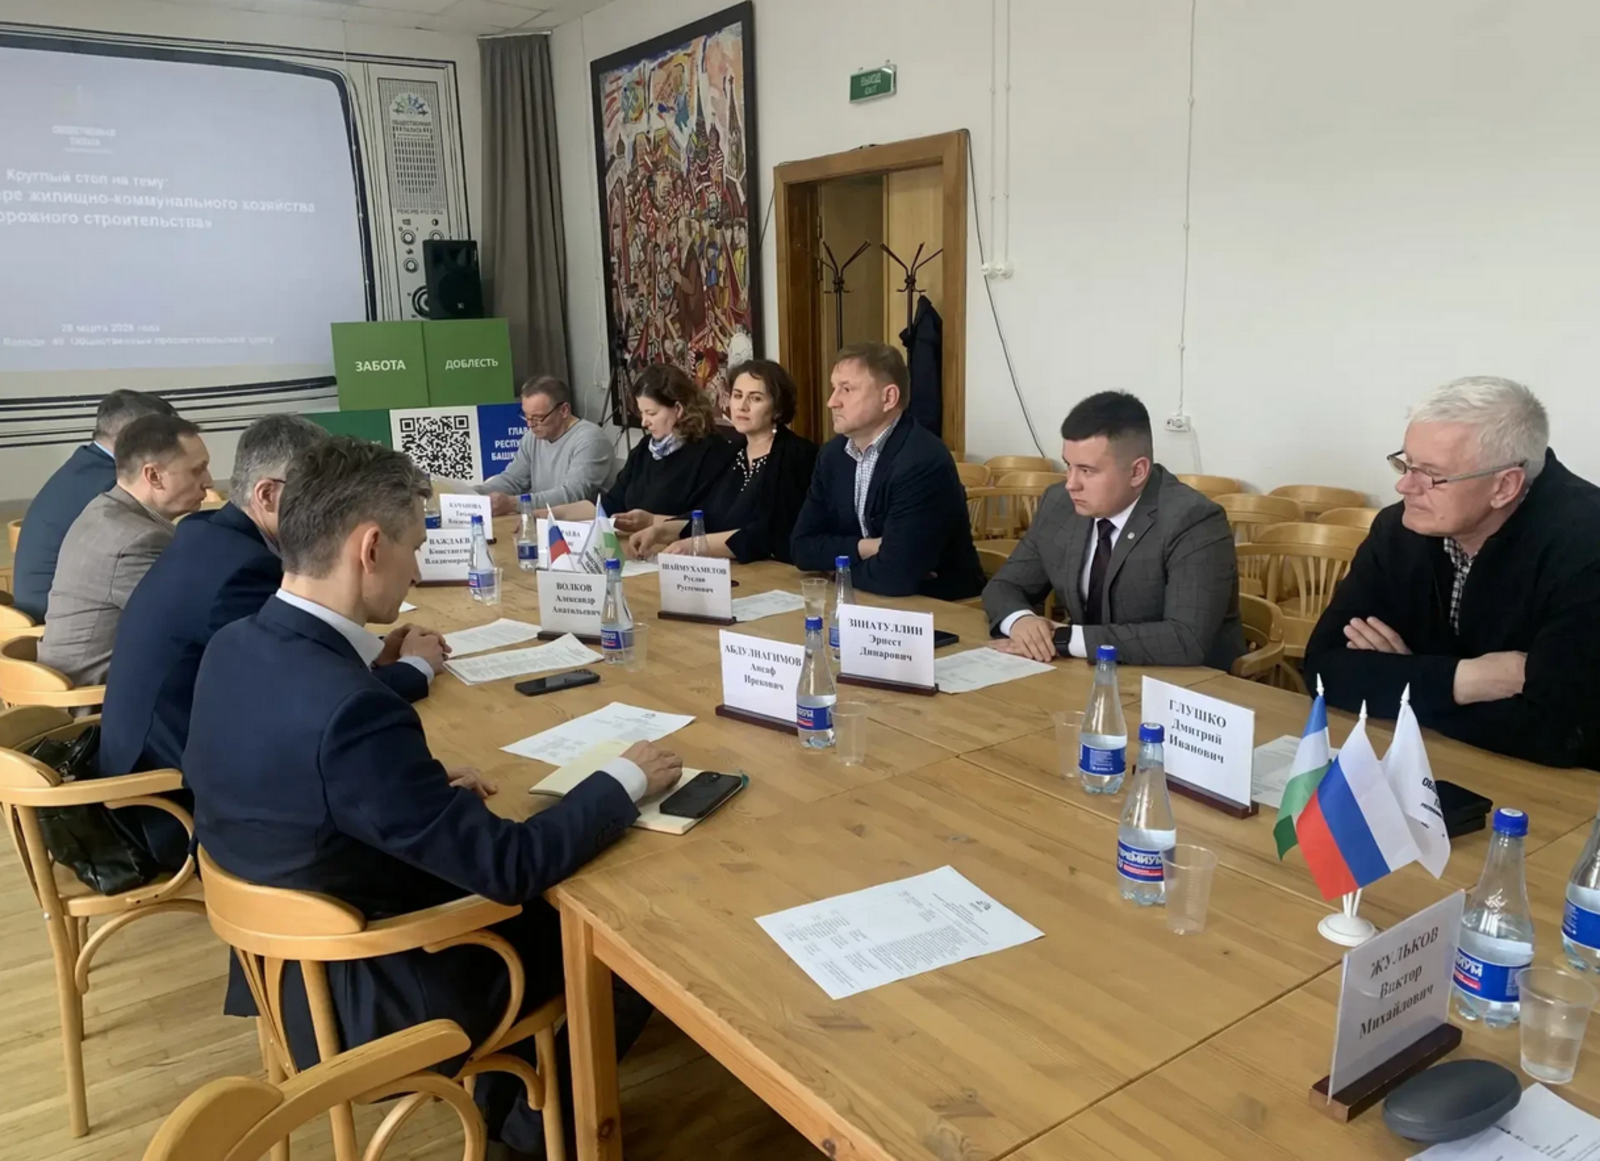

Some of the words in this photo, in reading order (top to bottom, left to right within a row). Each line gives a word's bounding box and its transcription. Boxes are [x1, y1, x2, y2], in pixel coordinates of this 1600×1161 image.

[6, 168, 71, 184] Круглый
[112, 175, 129, 186] на
[133, 177, 170, 190] тему:
[0, 190, 23, 204] ре
[29, 191, 238, 210] жилищно-коммунального
[241, 199, 316, 213] хозяйства
[83, 213, 212, 229] строительства»
[355, 359, 407, 372] ЗАБОТА
[445, 358, 499, 371] ДОБЛЕСТЬ
[494, 439, 521, 449] РЕСПУ
[662, 563, 727, 575] ШАЙМУХАМЕТОВ
[683, 574, 706, 583] Руслан
[556, 582, 593, 592] ВОЛКОВ
[677, 584, 714, 593] Рустемович
[555, 595, 596, 605] Александр
[552, 606, 601, 616] Анатольевич
[848, 618, 923, 635] ЗИНАТУЛЛИН
[869, 634, 902, 647] Эрнест
[724, 644, 802, 667] АБДУЛНАГИМОВ
[860, 647, 912, 662] Динарович
[751, 663, 777, 677] Ансаф
[744, 674, 784, 691] Ирекович
[1169, 699, 1227, 728] ГЛУШКО
[1171, 718, 1222, 745] Дмитрий
[1169, 734, 1224, 764] Иванович
[1370, 926, 1439, 979] ЖУЛЬКОВ
[1380, 965, 1422, 1000] Виктор
[1359, 984, 1434, 1039] Михайлович
